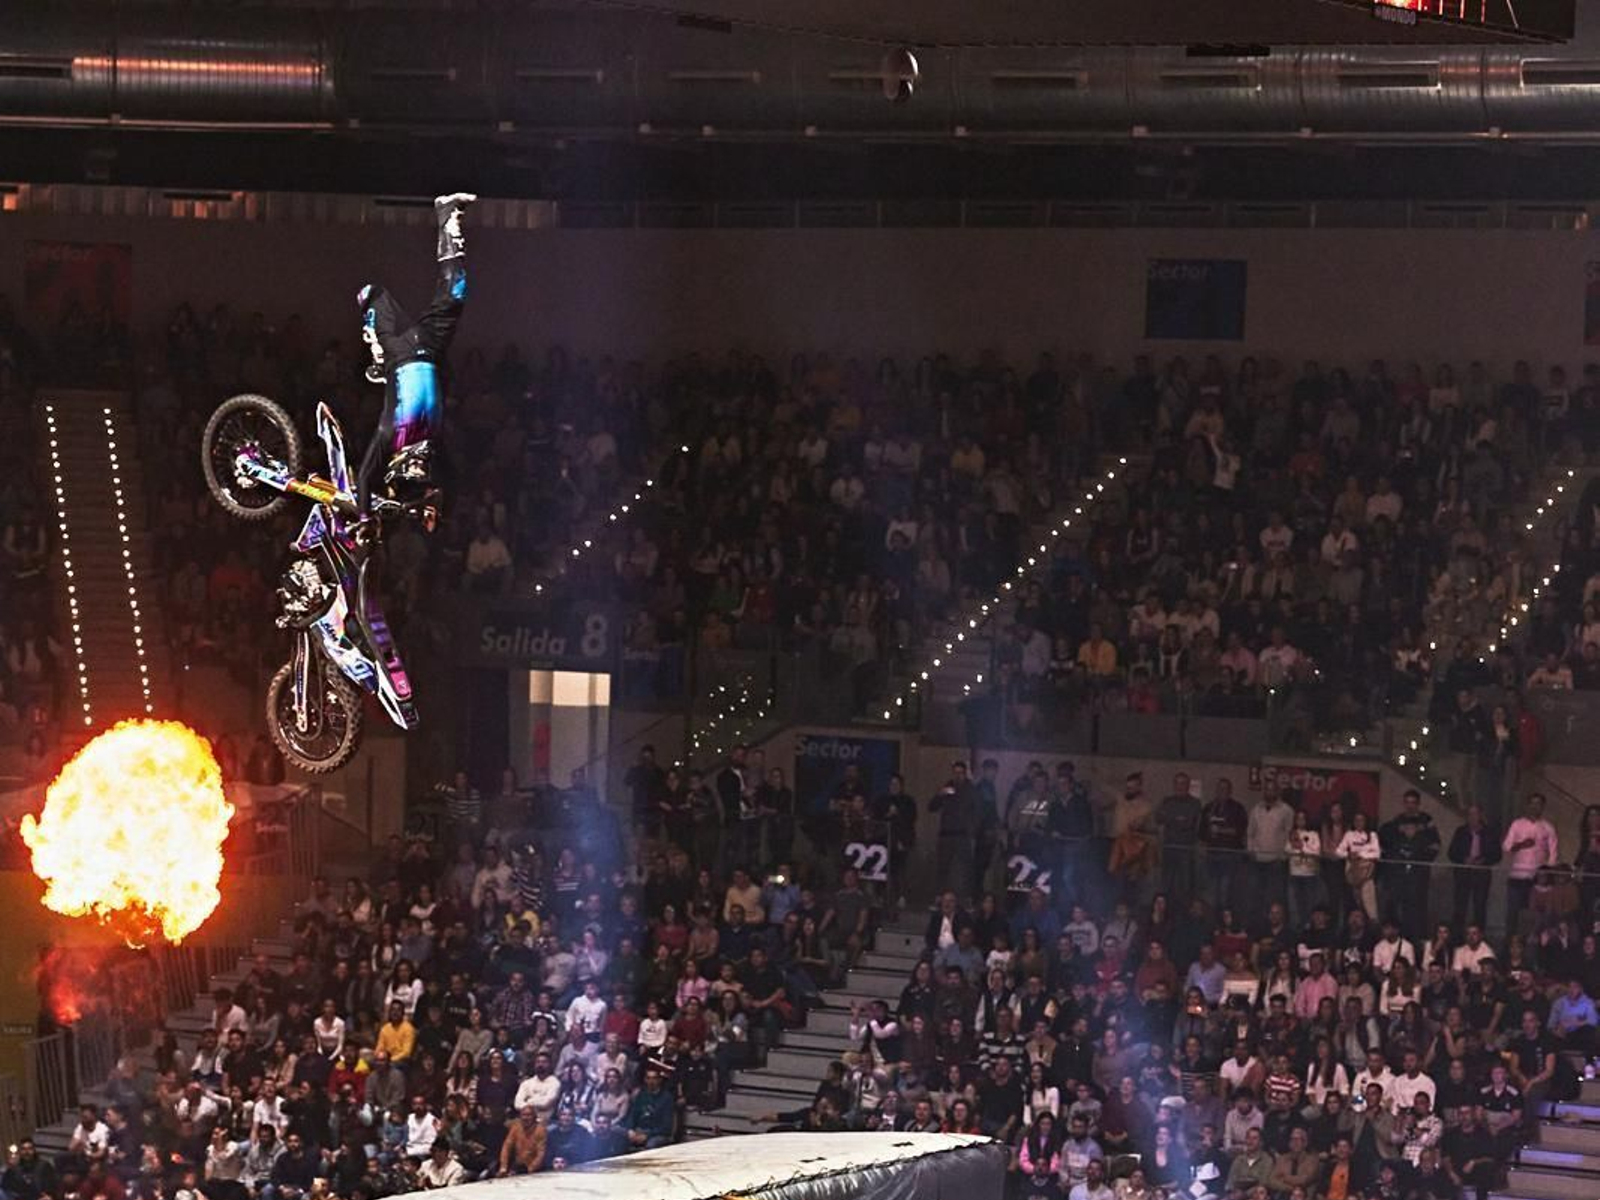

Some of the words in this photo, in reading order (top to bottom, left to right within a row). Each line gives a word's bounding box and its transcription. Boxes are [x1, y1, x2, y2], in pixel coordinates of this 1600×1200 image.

[481, 627, 567, 656] Salida
[580, 614, 609, 658] 8
[796, 736, 862, 760] Sector
[1264, 767, 1339, 792] Sector
[845, 842, 888, 881] 22
